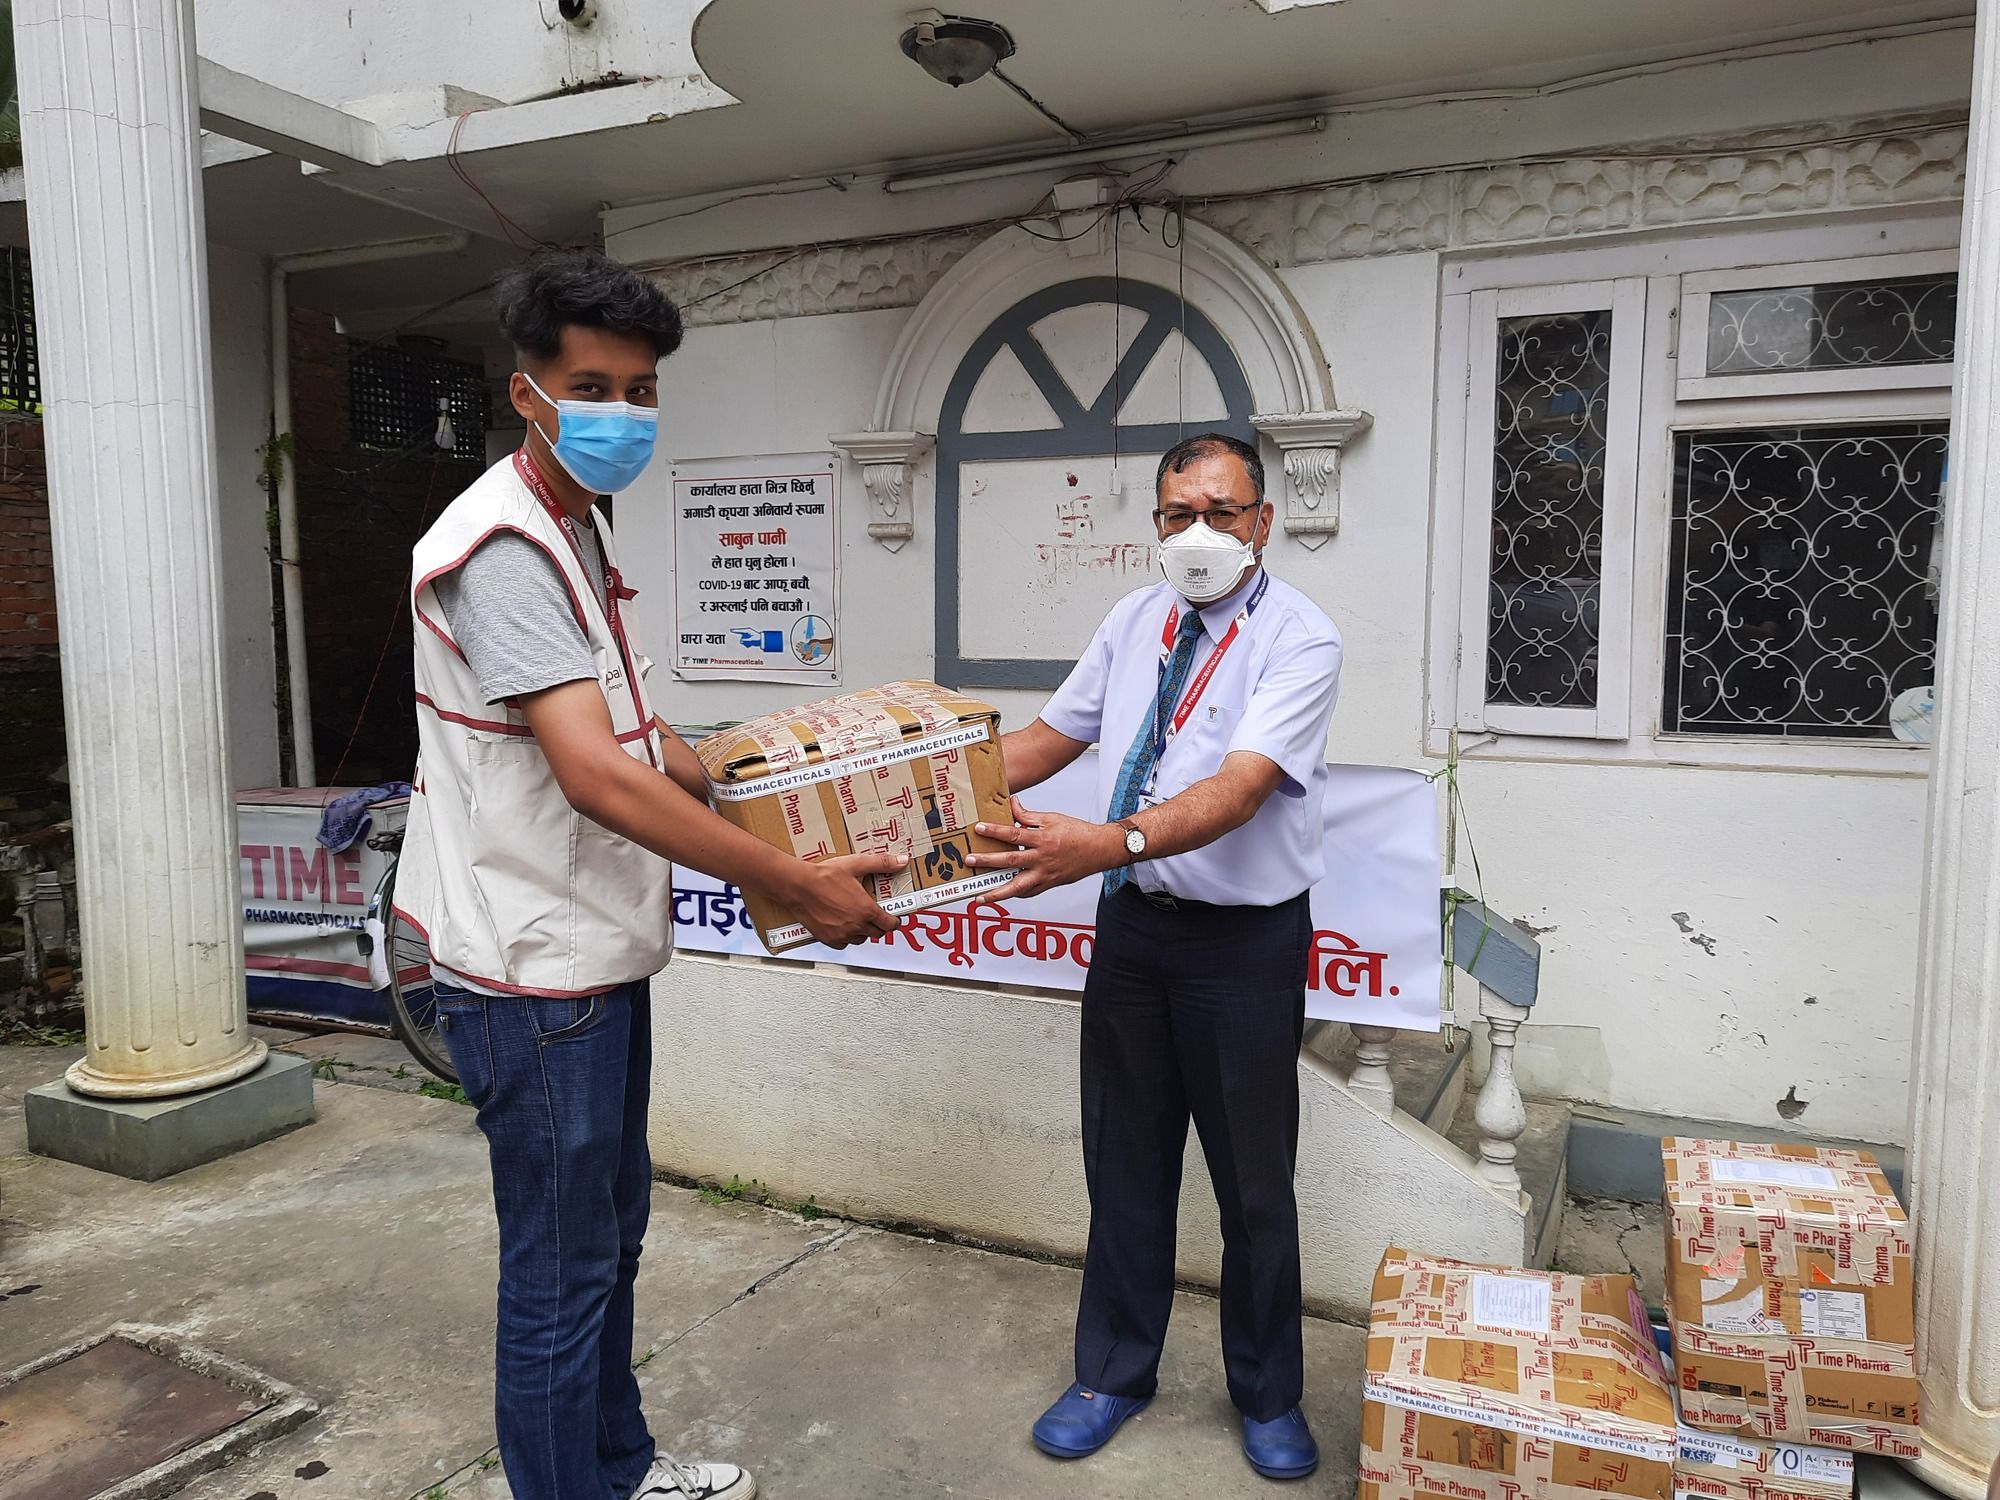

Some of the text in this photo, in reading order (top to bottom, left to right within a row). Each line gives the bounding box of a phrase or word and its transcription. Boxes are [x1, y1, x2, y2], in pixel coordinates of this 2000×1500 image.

[522, 462, 557, 508] Hami Nepal
[690, 483, 736, 496] कार्यालय
[739, 483, 762, 496] हाता
[765, 479, 788, 494] भित्र
[683, 505, 716, 519] अगाडी
[718, 506, 750, 520] कृपया
[752, 502, 793, 517] अनिवार्य
[718, 527, 788, 550] साबुन पानी
[711, 555, 722, 569] ले
[724, 557, 743, 569] हात
[763, 554, 788, 569] होला
[1186, 567, 1208, 577] 3M
[699, 580, 742, 590] COVID-19
[743, 579, 761, 590] बाट
[763, 579, 789, 592] आफू
[699, 601, 707, 612] र
[750, 598, 769, 612] पनि
[705, 634, 726, 645] यता
[710, 658, 764, 666] Pharmaceuticals
[1178, 648, 1224, 719] TIME PHARMACEUTICALS
[852, 728, 984, 769] TIME PHARMACEUTICALS
[728, 767, 831, 797] PHARMACEUTICALS
[934, 764, 958, 833] Time Pharma
[783, 793, 805, 836] Pharma
[240, 844, 365, 906] TIME
[933, 871, 1018, 899] TIME PHARMACE
[245, 908, 365, 931] PHARMACEUTICALS
[780, 927, 808, 940] TIME
[1784, 1191, 1855, 1203] Time Pharma
[1700, 1216, 1715, 1239] Time
[1793, 1231, 1809, 1242] me
[1760, 1229, 1775, 1253] Time
[1838, 1231, 1852, 1269] Pharma
[1873, 1246, 1889, 1284] Pharma
[1415, 1303, 1436, 1311] Time
[1768, 1280, 1784, 1318] Pharma
[1476, 1325, 1536, 1340] Time Pharma
[1596, 1320, 1619, 1332] Time
[1610, 1341, 1631, 1361] Time
[1708, 1341, 1733, 1356] Time
[1815, 1351, 1890, 1372] Time Pharma
[1395, 1395, 1494, 1422] PHARMACEUTICALS
[1769, 1370, 1788, 1431] Time Pharma
[1400, 1410, 1416, 1445] Pharma
[1702, 1409, 1742, 1425] Pharma
[1515, 1421, 1647, 1454] TIME PHARMACEUTICALS
[1678, 1435, 1754, 1458] MACEUTICALS
[1809, 1428, 1919, 1457] Pharma Time
[1681, 1449, 1716, 1464] LASER
[1767, 1446, 1799, 1470] 70
[1422, 1477, 1486, 1500] Time Pharma
[1687, 1477, 1727, 1496] Pharma
